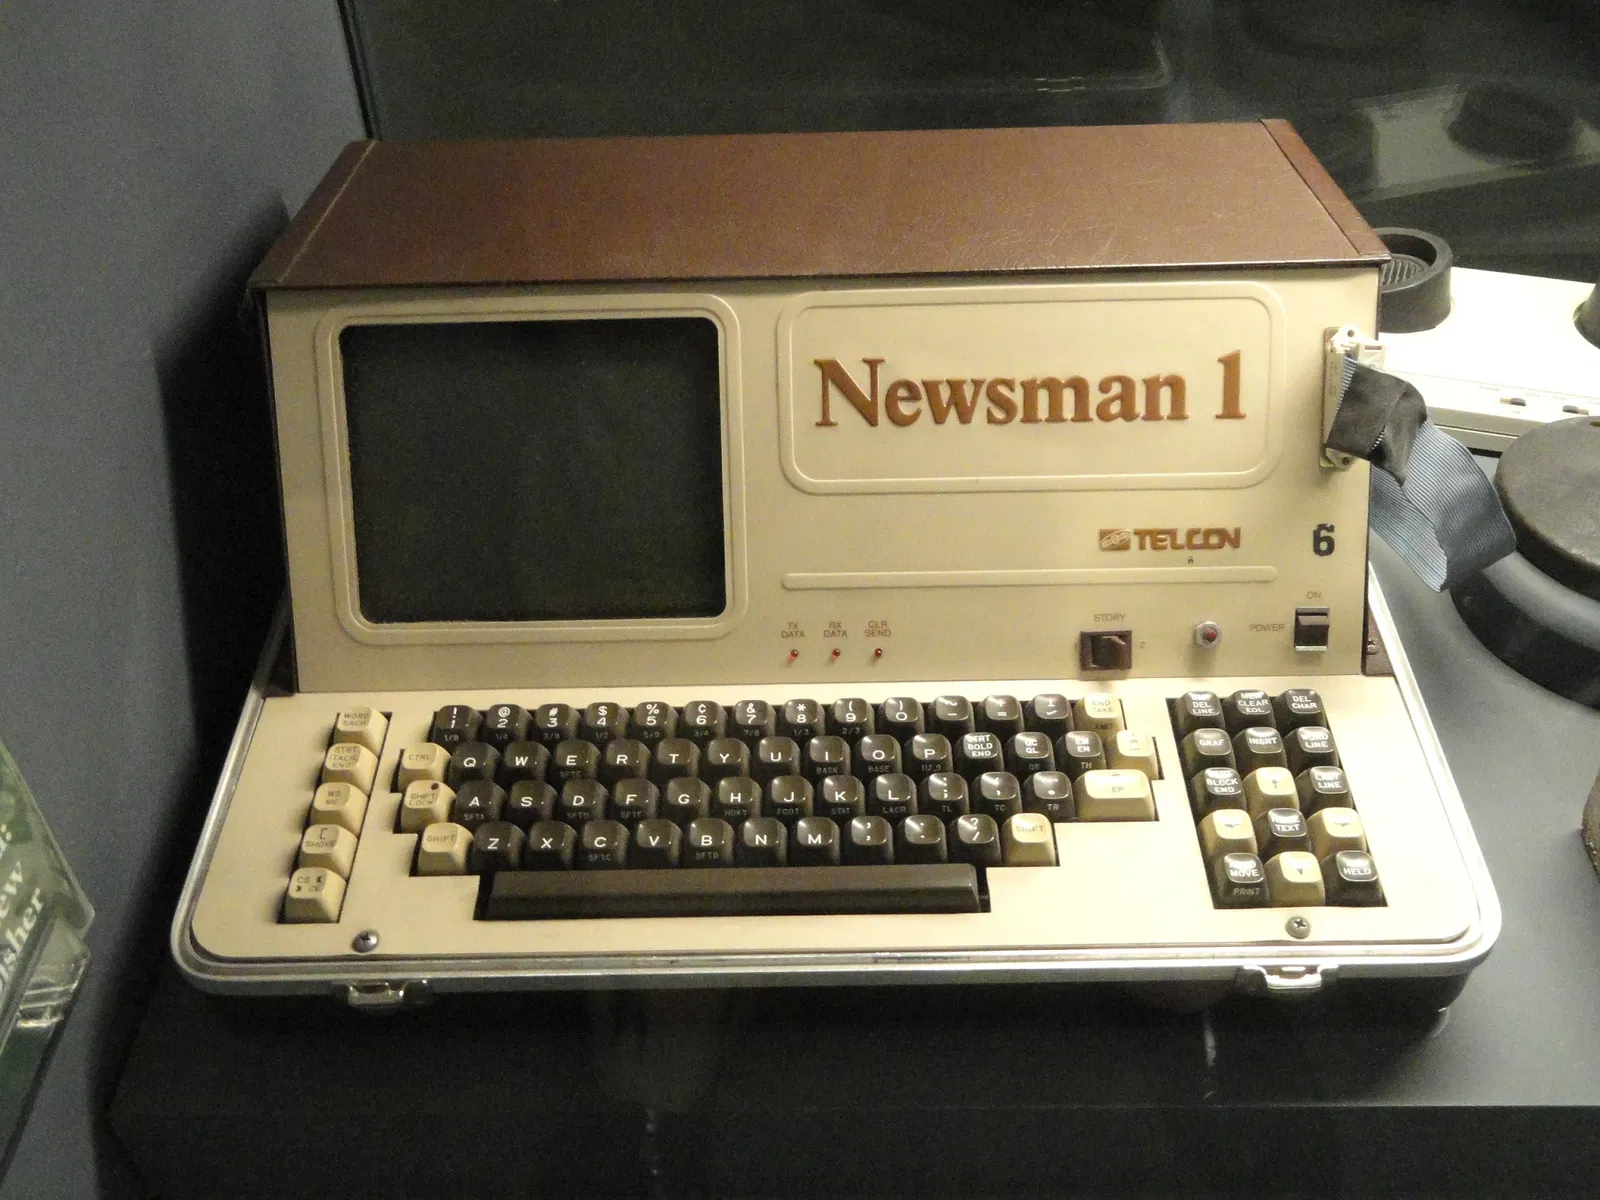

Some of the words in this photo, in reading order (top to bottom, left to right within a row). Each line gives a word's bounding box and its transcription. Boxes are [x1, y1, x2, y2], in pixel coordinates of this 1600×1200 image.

[813, 357, 1189, 427] Newsman
[1215, 349, 1246, 420] 1
[1134, 526, 1241, 550] TELCON
[1313, 523, 1336, 557] 6
[1307, 591, 1321, 599] ON
[1094, 613, 1125, 622] STORY
[829, 621, 842, 629] RX
[868, 619, 888, 629] CLR
[1249, 622, 1285, 632] POWER
[781, 630, 805, 638] DATA
[823, 629, 848, 638] DATA
[865, 629, 892, 638] SEND
[1139, 641, 1146, 649] 2
[1237, 698, 1270, 708] CLEAR
[1292, 695, 1313, 703] DEL
[646, 703, 660, 715] %
[746, 702, 757, 714] &
[848, 700, 854, 712] (
[899, 700, 904, 711] )
[1192, 700, 1212, 709] DEL
[1291, 701, 1319, 710] CHAR
[452, 707, 457, 718] !
[497, 706, 511, 718] @
[549, 707, 559, 717] #
[598, 704, 608, 717] $
[344, 712, 369, 720] WORD
[597, 716, 607, 726] 4
[646, 715, 657, 726] 5
[696, 715, 707, 725] 6
[746, 714, 757, 724] 7
[796, 713, 807, 723] 8
[845, 712, 857, 722] 9
[342, 719, 367, 727] SRCH
[450, 719, 456, 729] 1
[497, 718, 509, 728] 2
[547, 717, 558, 728] 3
[743, 729, 760, 738] 7/8
[793, 728, 809, 737] 1/3
[842, 726, 861, 735] 2/3
[444, 734, 459, 742] 1/8
[495, 732, 509, 740] 1/4
[595, 732, 609, 740] 1/2
[1248, 736, 1279, 746] INSRT
[968, 742, 993, 750] BOLD
[1198, 738, 1226, 748] GRAF
[1305, 740, 1330, 749] LINE
[923, 748, 936, 759] P
[1025, 746, 1040, 754] QL
[1077, 745, 1091, 753] EN
[408, 753, 430, 761] CTRL
[515, 756, 529, 767] W
[565, 754, 578, 766] E
[616, 754, 628, 765] R
[669, 753, 680, 764] T
[719, 752, 730, 763] Y
[770, 751, 782, 762] U
[463, 757, 477, 768] Q
[1080, 760, 1093, 769] TH
[868, 764, 891, 773] BASE
[1206, 777, 1240, 787] BLOCK
[1318, 780, 1343, 789] LINE
[888, 789, 900, 800] L
[1112, 786, 1125, 794] EP
[1214, 786, 1236, 794] END
[468, 796, 481, 807] A
[520, 796, 533, 807] S
[572, 795, 585, 806] D
[625, 793, 638, 805] F
[678, 793, 690, 804] G
[730, 792, 742, 804] H
[783, 791, 795, 803] J
[835, 791, 847, 802] K
[942, 803, 953, 812] TL
[994, 804, 1006, 812] TC
[1046, 803, 1060, 811] TR
[970, 817, 980, 831] ?
[1274, 823, 1302, 832] TEXT
[425, 835, 457, 843] SHIFT
[649, 836, 660, 847] V
[701, 835, 713, 846] B
[755, 834, 767, 845] N
[807, 833, 822, 845] M
[972, 831, 980, 842] /
[487, 838, 500, 850] Z
[540, 837, 553, 849] X
[593, 836, 607, 848] C
[1230, 868, 1261, 878] MOVE
[1343, 866, 1373, 877] HELD
[1232, 887, 1261, 897] PRINT
